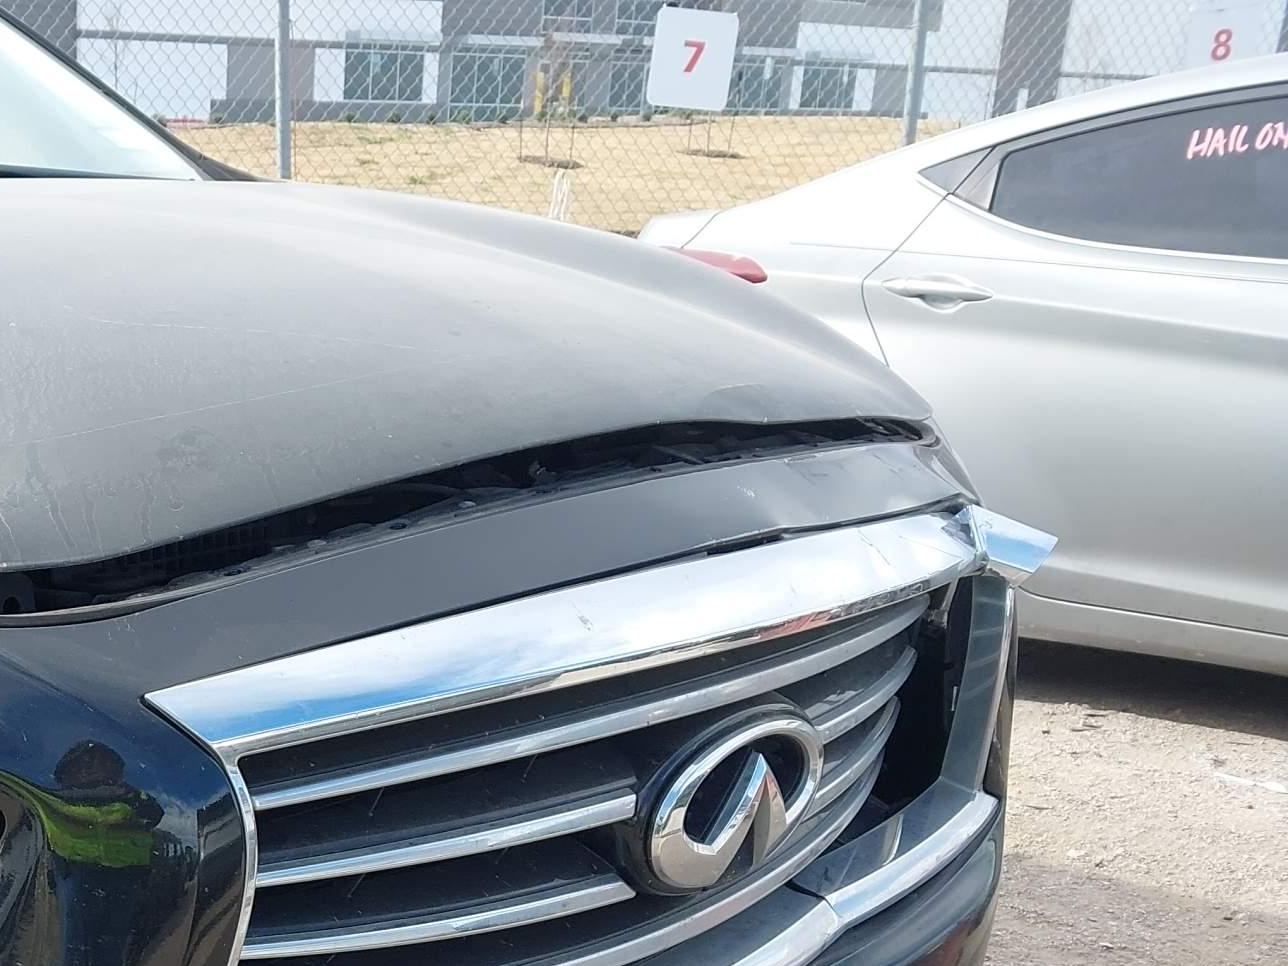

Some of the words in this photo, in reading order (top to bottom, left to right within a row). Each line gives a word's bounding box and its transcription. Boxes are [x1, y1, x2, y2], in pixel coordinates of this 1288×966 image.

[683, 39, 706, 73] 7
[1211, 28, 1233, 61] 8
[1186, 125, 1249, 160] HAIL
